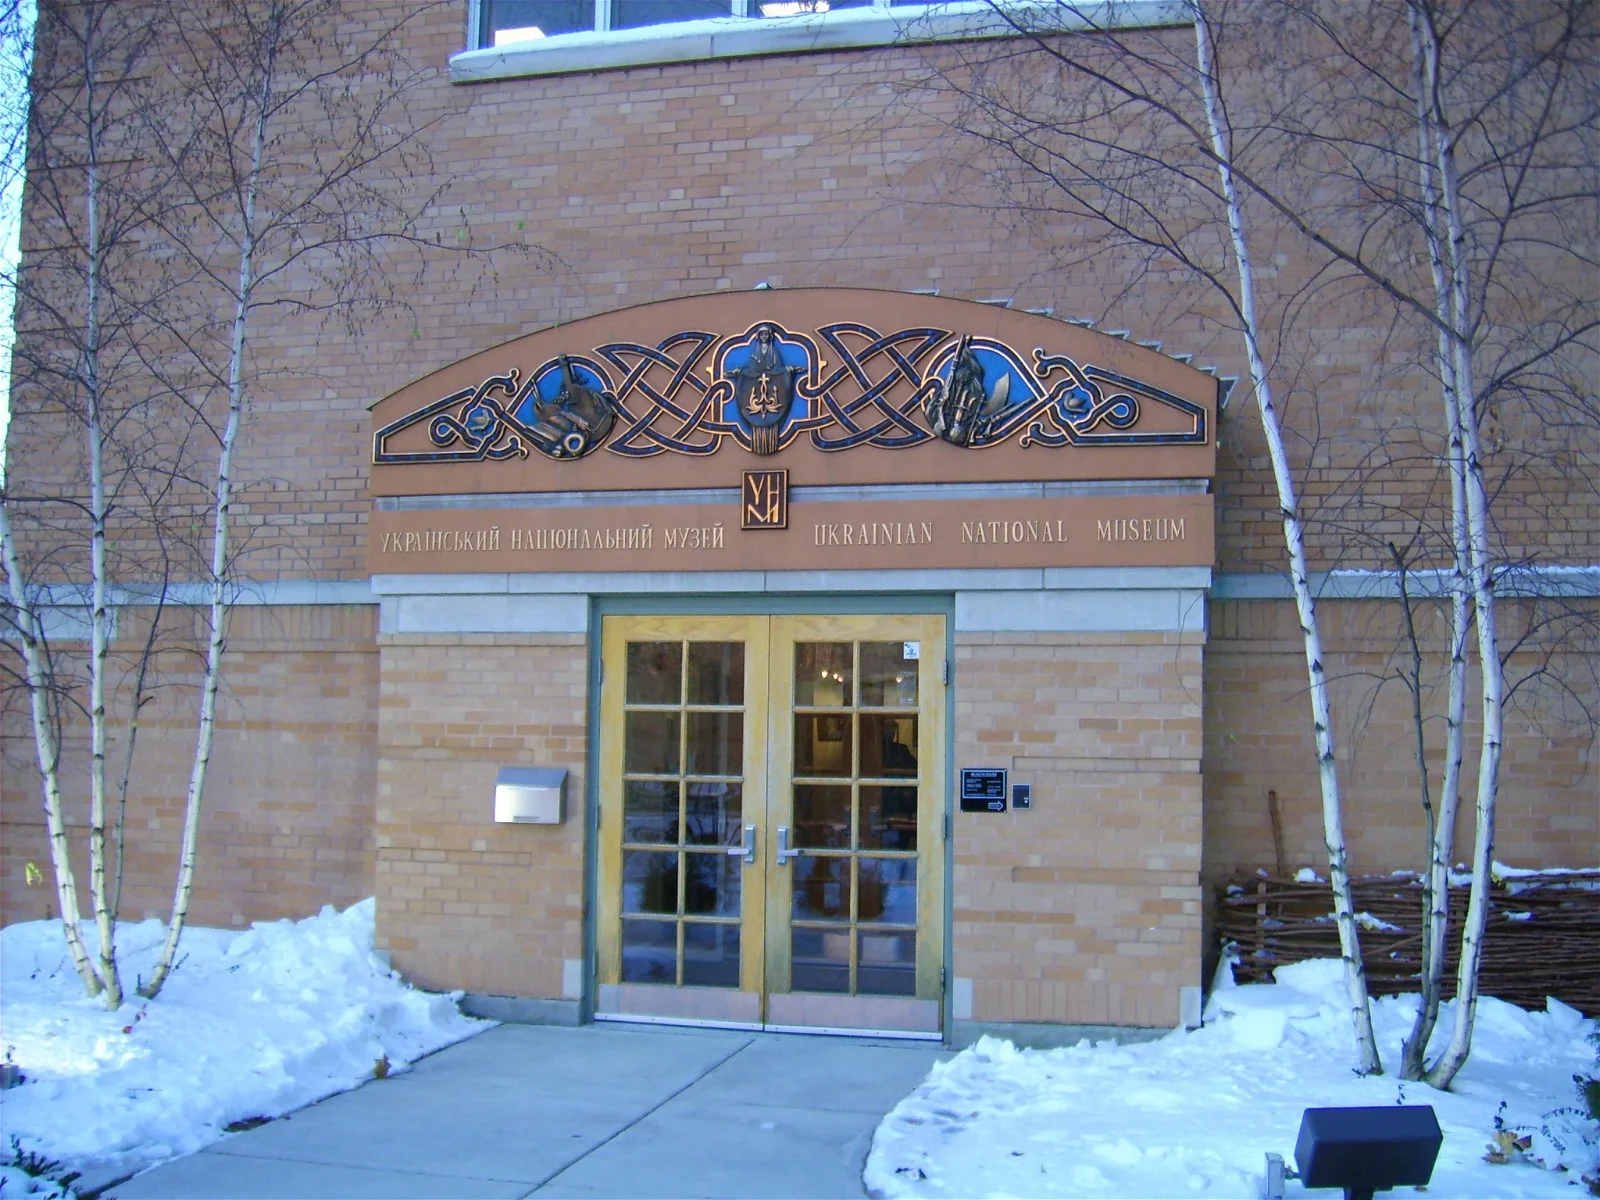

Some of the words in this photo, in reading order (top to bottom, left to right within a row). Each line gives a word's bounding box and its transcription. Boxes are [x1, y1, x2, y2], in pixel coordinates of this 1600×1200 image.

[511, 523, 653, 550] НАЦІОНАЛЬНИЙ
[664, 522, 725, 549] МУЗЕЙ
[814, 522, 933, 546] UKRAINIAN
[961, 519, 1068, 544] NATIONAL
[1097, 517, 1187, 542] MUSEUM
